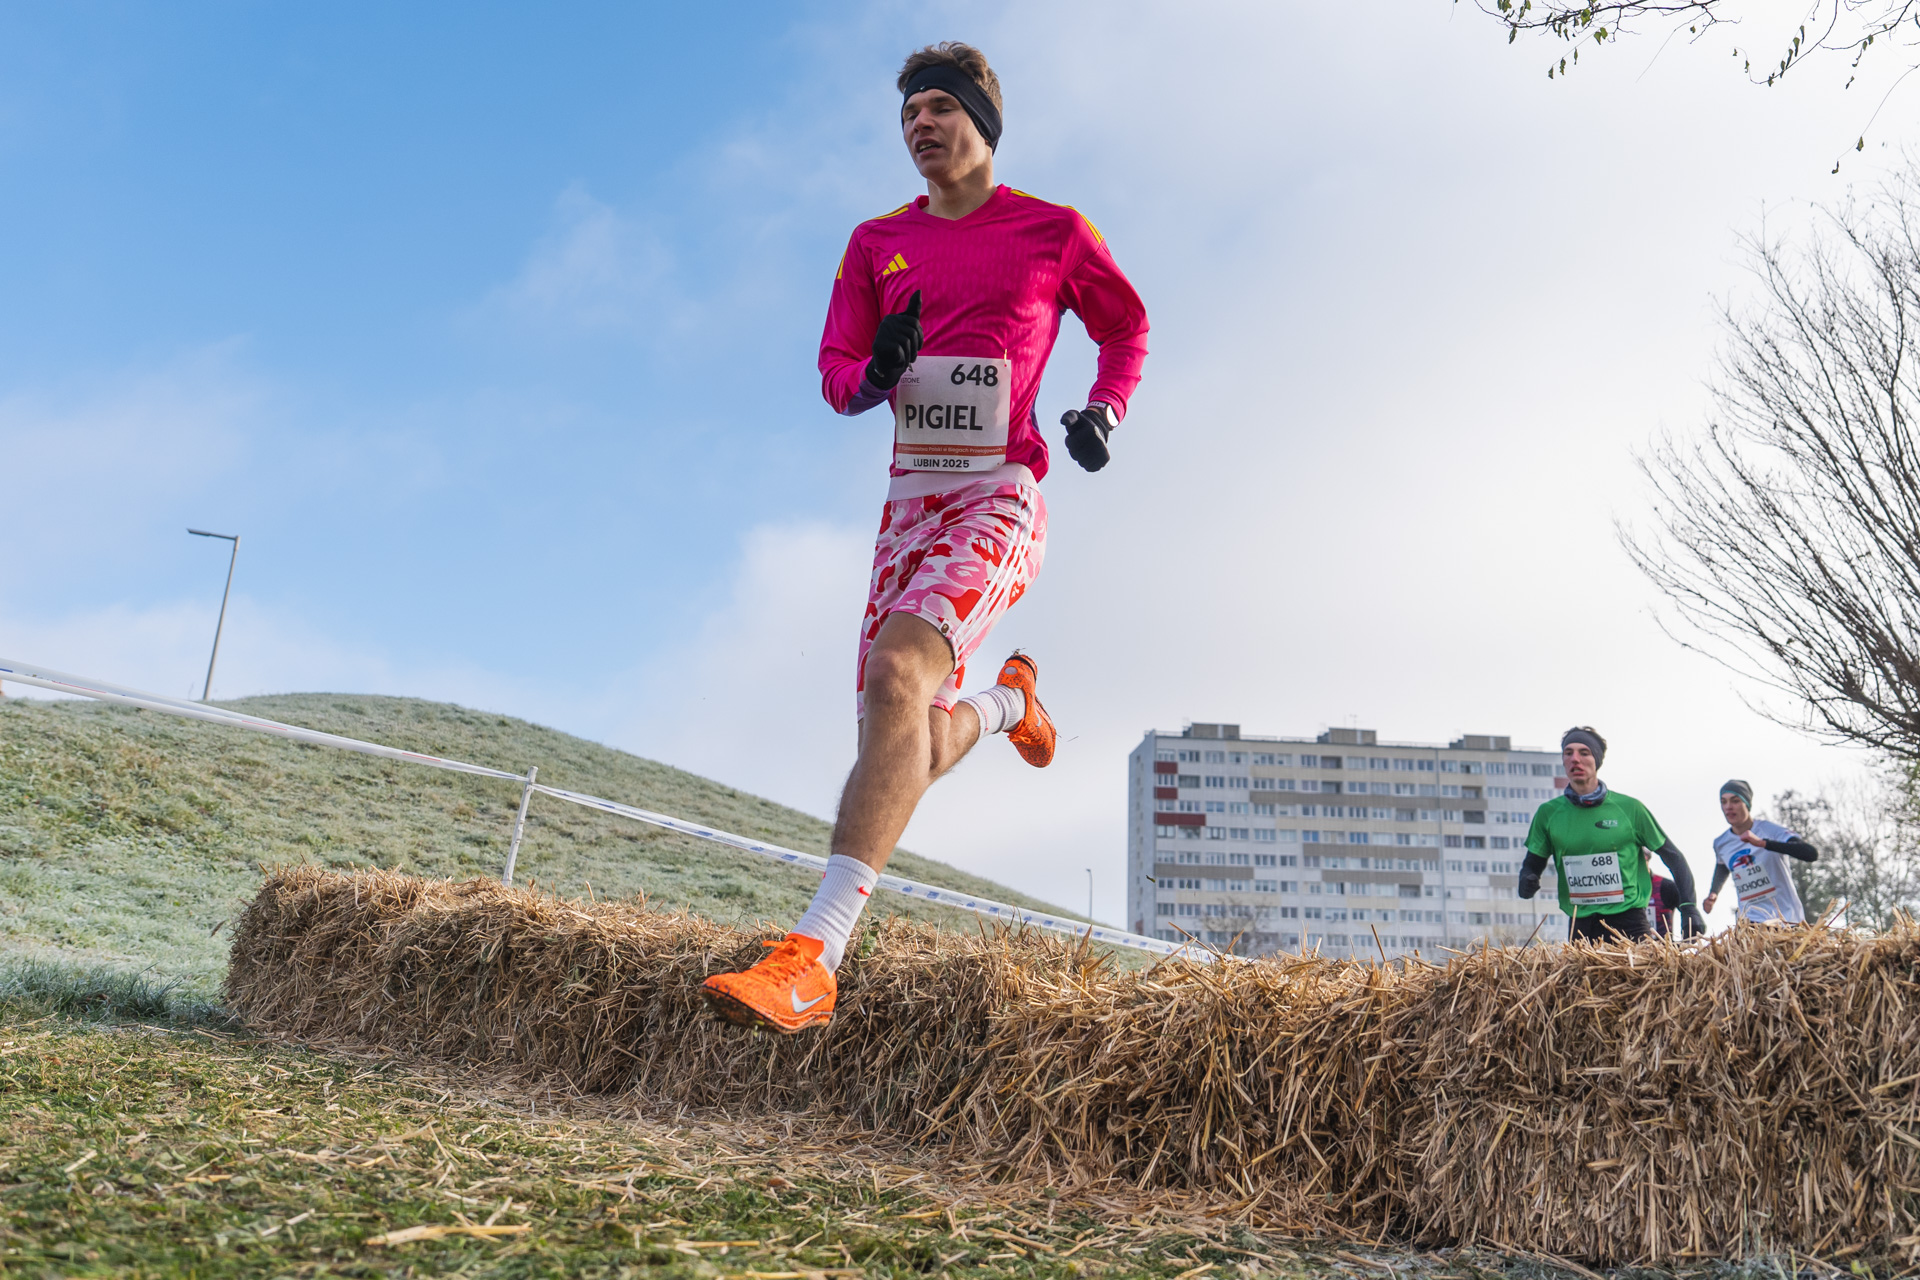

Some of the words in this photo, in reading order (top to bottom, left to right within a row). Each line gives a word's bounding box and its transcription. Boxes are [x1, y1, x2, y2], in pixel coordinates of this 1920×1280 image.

[950, 364, 998, 387] 648
[905, 404, 983, 431] PIGIEL
[913, 458, 940, 468] LUBIN
[942, 458, 970, 468] 2025
[1591, 855, 1613, 867] 688
[1746, 865, 1762, 876] 210
[1567, 872, 1620, 887] GAŁCZYŃSKI
